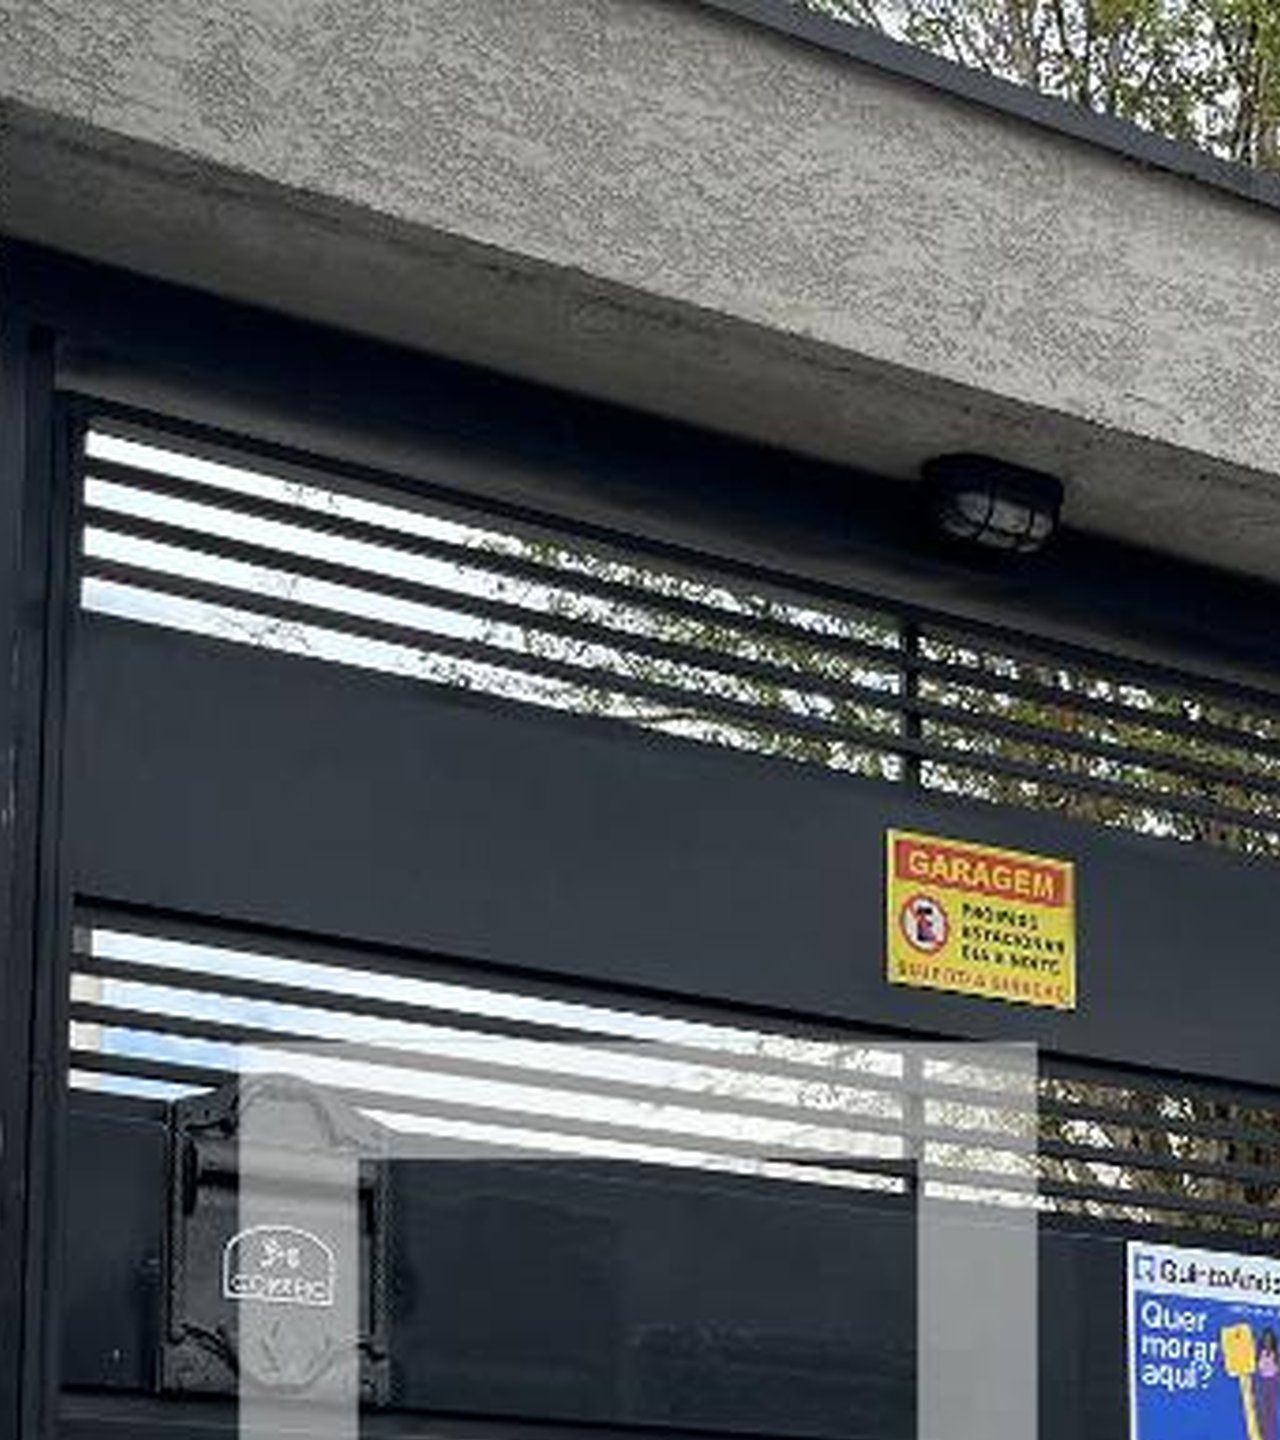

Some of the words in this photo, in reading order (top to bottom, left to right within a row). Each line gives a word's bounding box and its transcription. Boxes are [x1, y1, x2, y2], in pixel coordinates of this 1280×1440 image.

[908, 850, 1055, 899] GARAGEM
[1141, 1300, 1208, 1332] Quer
[1141, 1335, 1218, 1362] morar
[1141, 1361, 1214, 1391] aqui?
